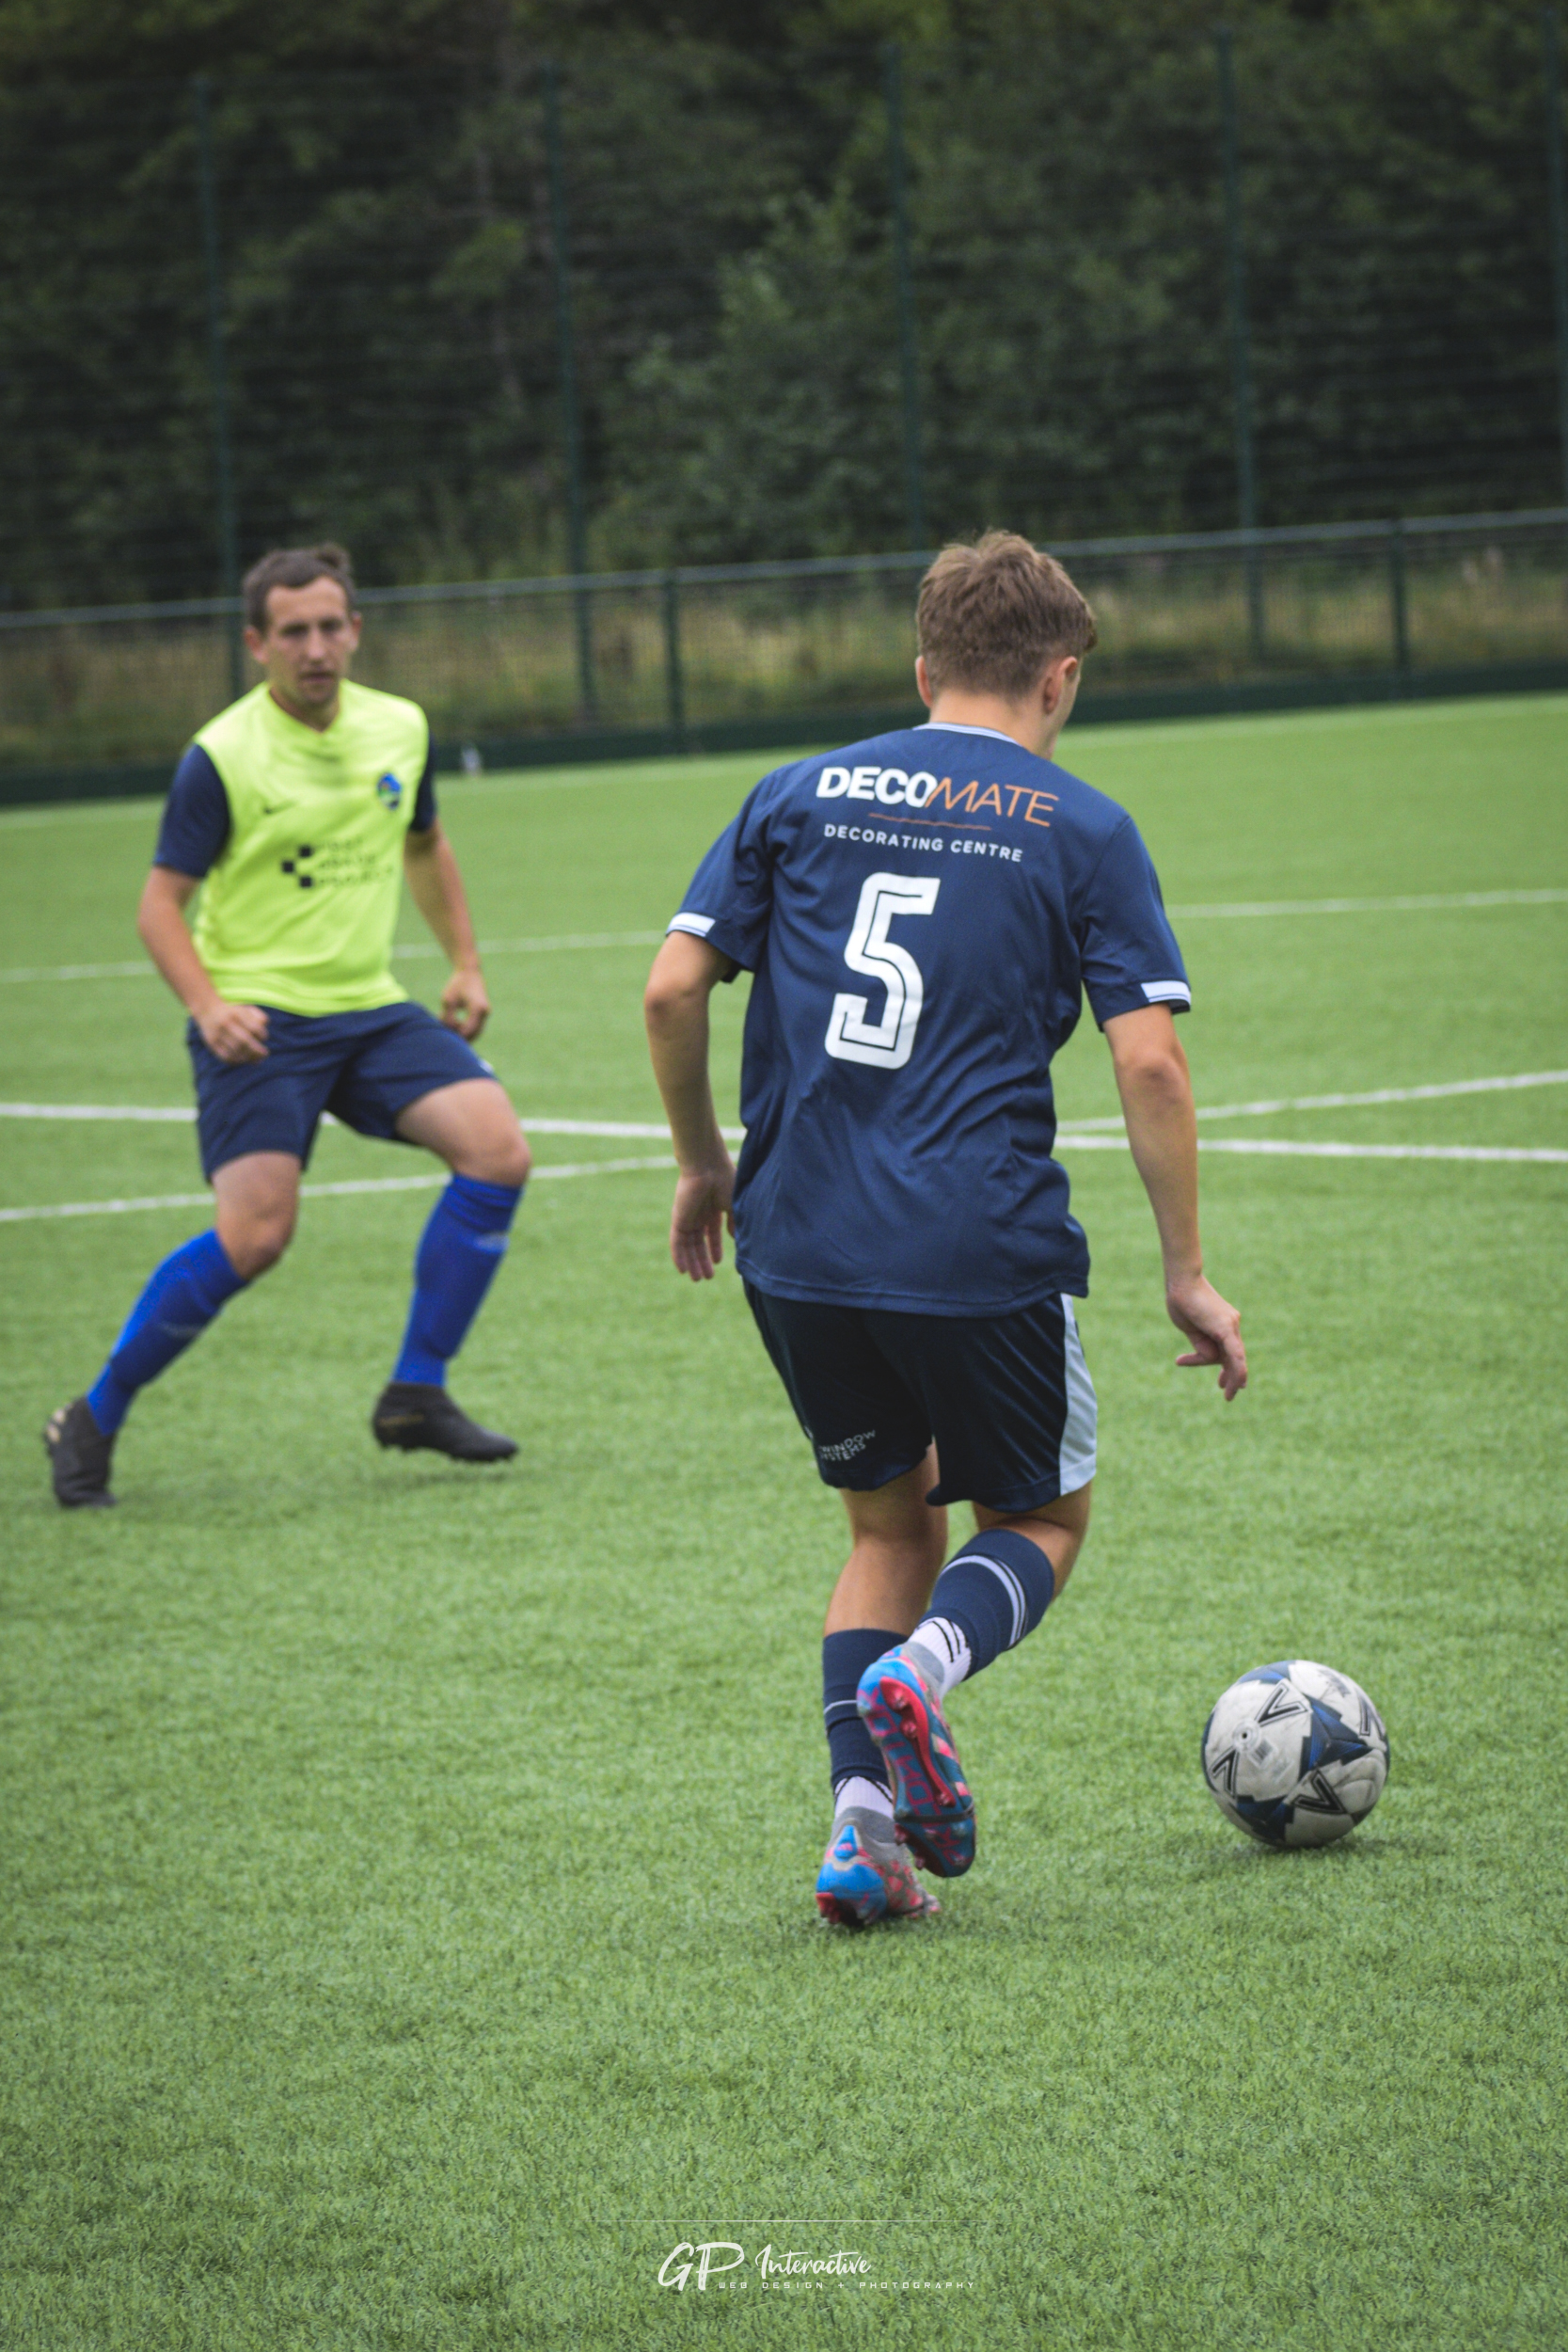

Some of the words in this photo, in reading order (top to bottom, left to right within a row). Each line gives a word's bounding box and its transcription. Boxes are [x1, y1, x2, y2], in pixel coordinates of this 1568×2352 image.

[816, 766, 1059, 828] DECOMATE
[823, 823, 943, 851] DECORATING
[950, 839, 1023, 863] CENTRE
[824, 871, 941, 1070] 5
[817, 1429, 876, 1453] WINDOW
